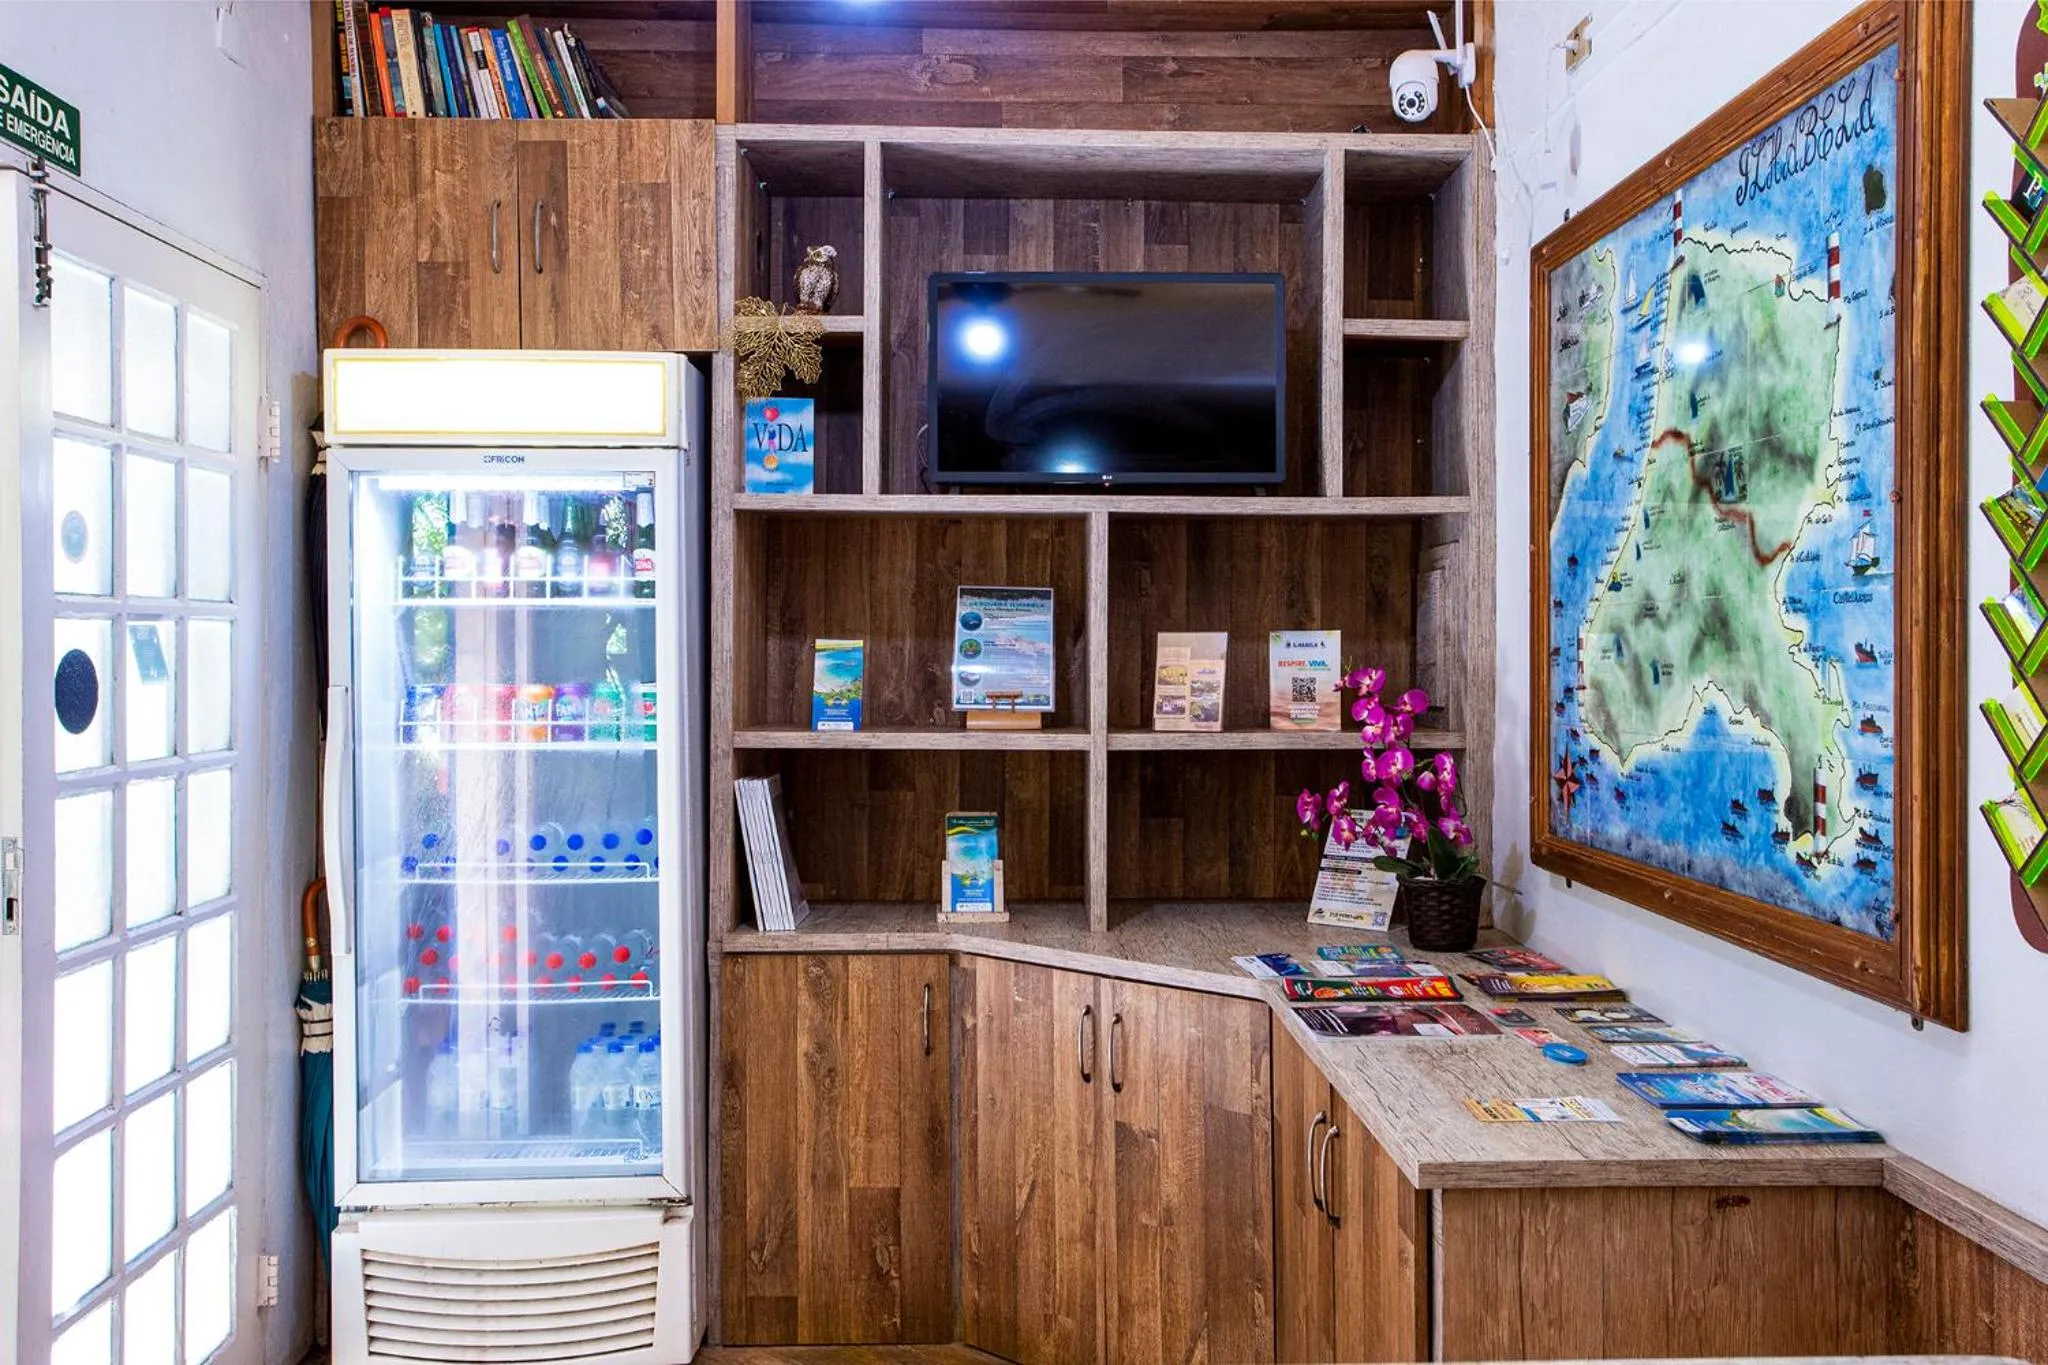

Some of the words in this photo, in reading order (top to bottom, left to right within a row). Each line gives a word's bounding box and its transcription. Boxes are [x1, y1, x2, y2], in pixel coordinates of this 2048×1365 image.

[0, 73, 71, 141] SAÍDA
[6, 112, 76, 167] EMERGÊNCIA
[491, 455, 525, 463] FRICON
